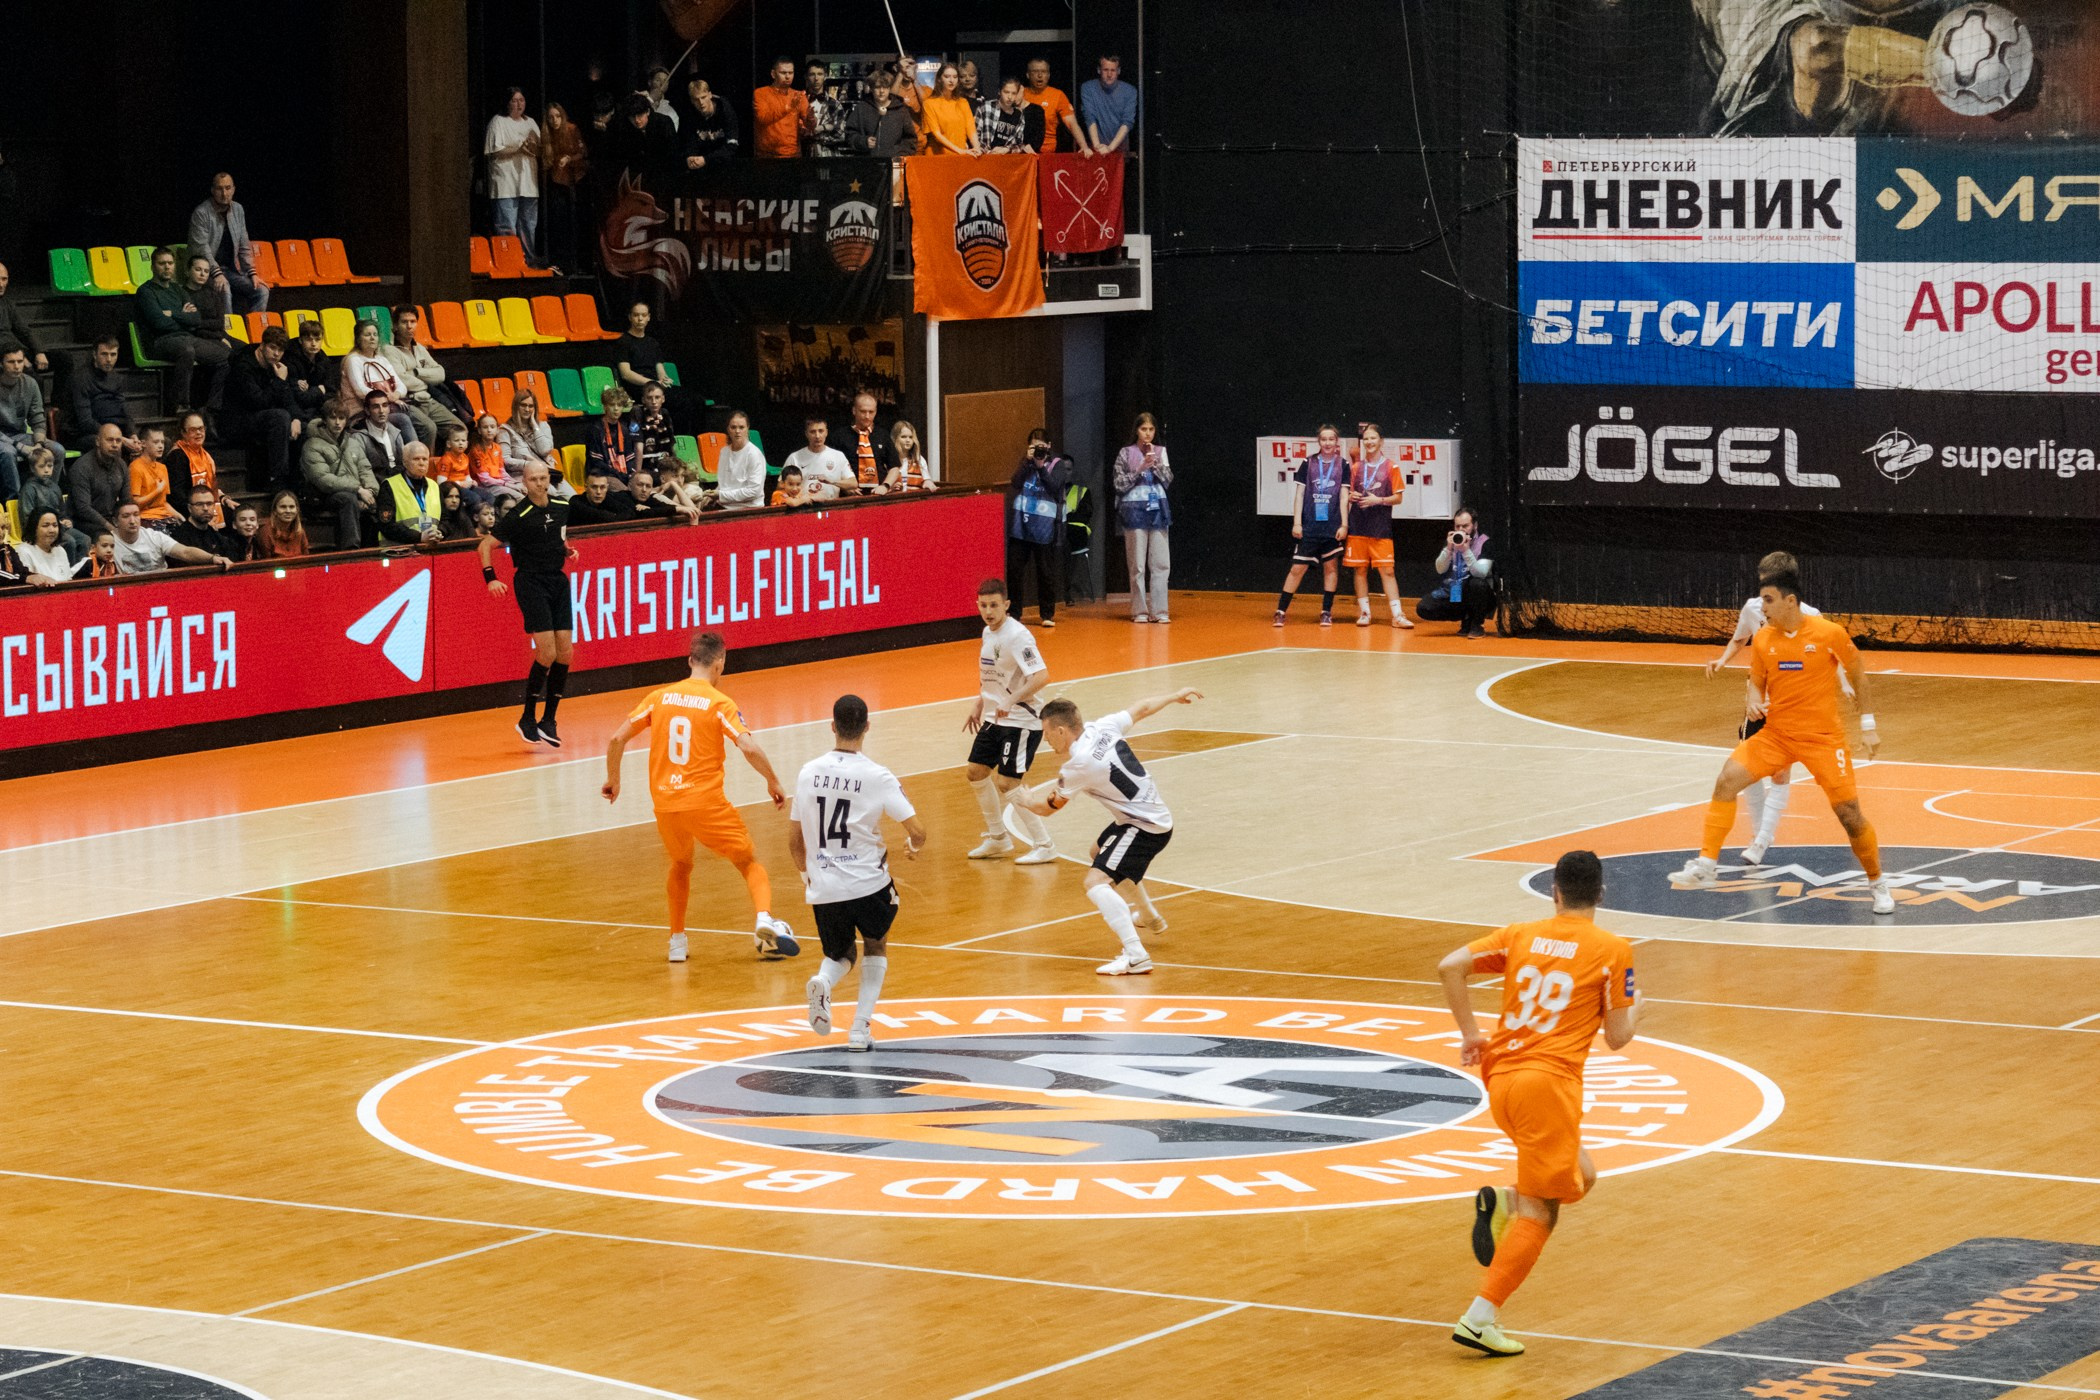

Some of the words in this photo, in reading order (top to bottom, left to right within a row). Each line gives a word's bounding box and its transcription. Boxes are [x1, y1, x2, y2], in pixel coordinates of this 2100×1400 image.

[1557, 158, 1696, 172] ПЕТЕРБУРГСКИЙ
[674, 197, 820, 233] НЕВСКИЕ
[1532, 178, 1842, 229] ДНЕВНИК
[698, 237, 791, 272] ЛИСЫ
[1529, 299, 1842, 348] БЕТСИТИ
[2045, 349, 2100, 384] ge
[1528, 406, 1841, 487] JÖGEL
[2, 606, 236, 717] СЫВАЙСЯ
[662, 692, 711, 711] САЛЬНИКОВ
[668, 716, 692, 765] 8
[1003, 742, 1011, 756] 8
[1835, 748, 1846, 768] 9
[813, 775, 862, 793] САЛХИ
[1109, 739, 1146, 801] 10
[816, 796, 851, 849] 14
[1504, 965, 1574, 1034] 39
[515, 1018, 848, 1068] TRAIN
[871, 1006, 1228, 1029] HARD
[1254, 1011, 1426, 1036] BE
[453, 1073, 684, 1168] HUMBLE
[655, 1160, 856, 1193] BE
[881, 1170, 1317, 1201] HARD
